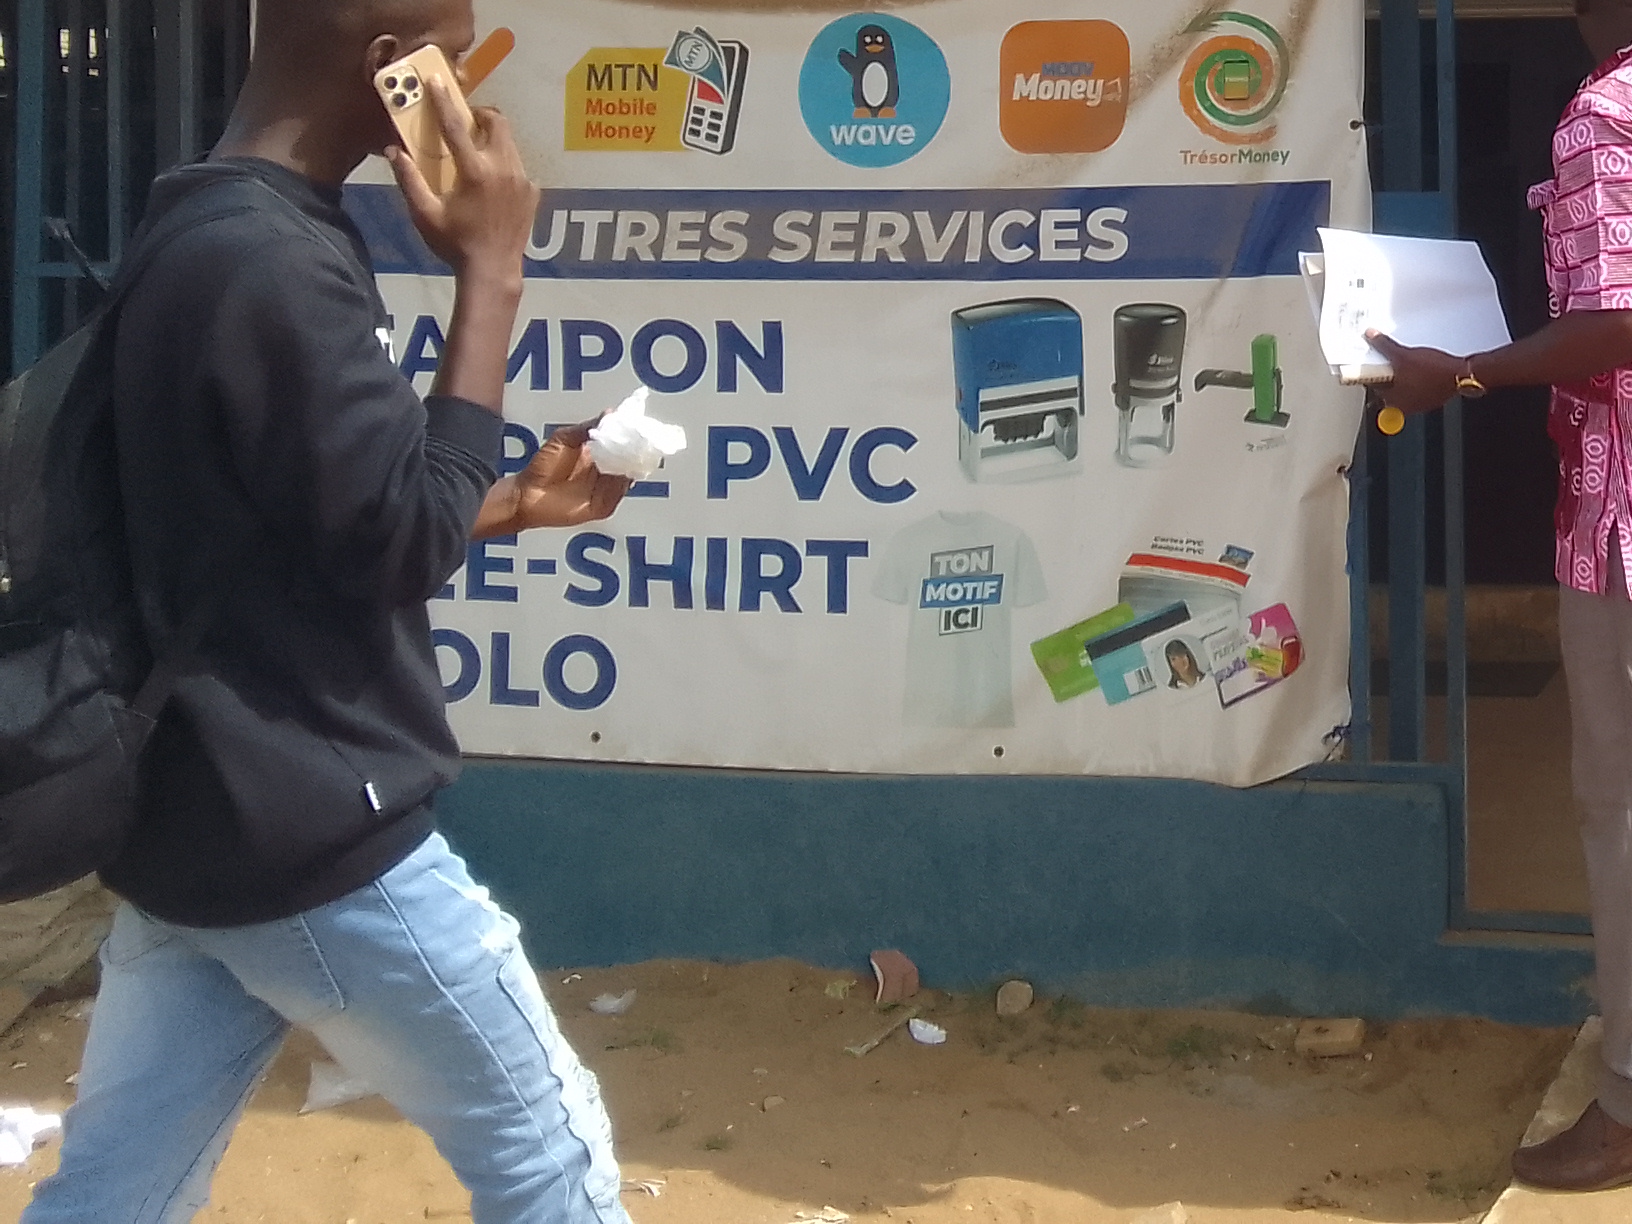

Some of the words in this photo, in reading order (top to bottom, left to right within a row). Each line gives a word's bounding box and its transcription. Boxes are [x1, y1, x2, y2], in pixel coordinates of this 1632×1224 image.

[684, 41, 704, 67] MTN
[585, 63, 659, 92] MTN
[1012, 73, 1105, 107] Money
[584, 97, 658, 117] Mobile
[584, 120, 657, 144] Money
[830, 122, 916, 147] wave
[523, 209, 750, 262] UTRES
[766, 206, 1130, 264] SERVICES
[386, 314, 785, 395] AMPON
[706, 425, 918, 505] PVC
[430, 532, 870, 615] E-SHIRT
[934, 550, 990, 576] TON
[925, 580, 999, 603] MOTIF
[943, 606, 979, 631] ICI
[430, 629, 618, 711] OLO
